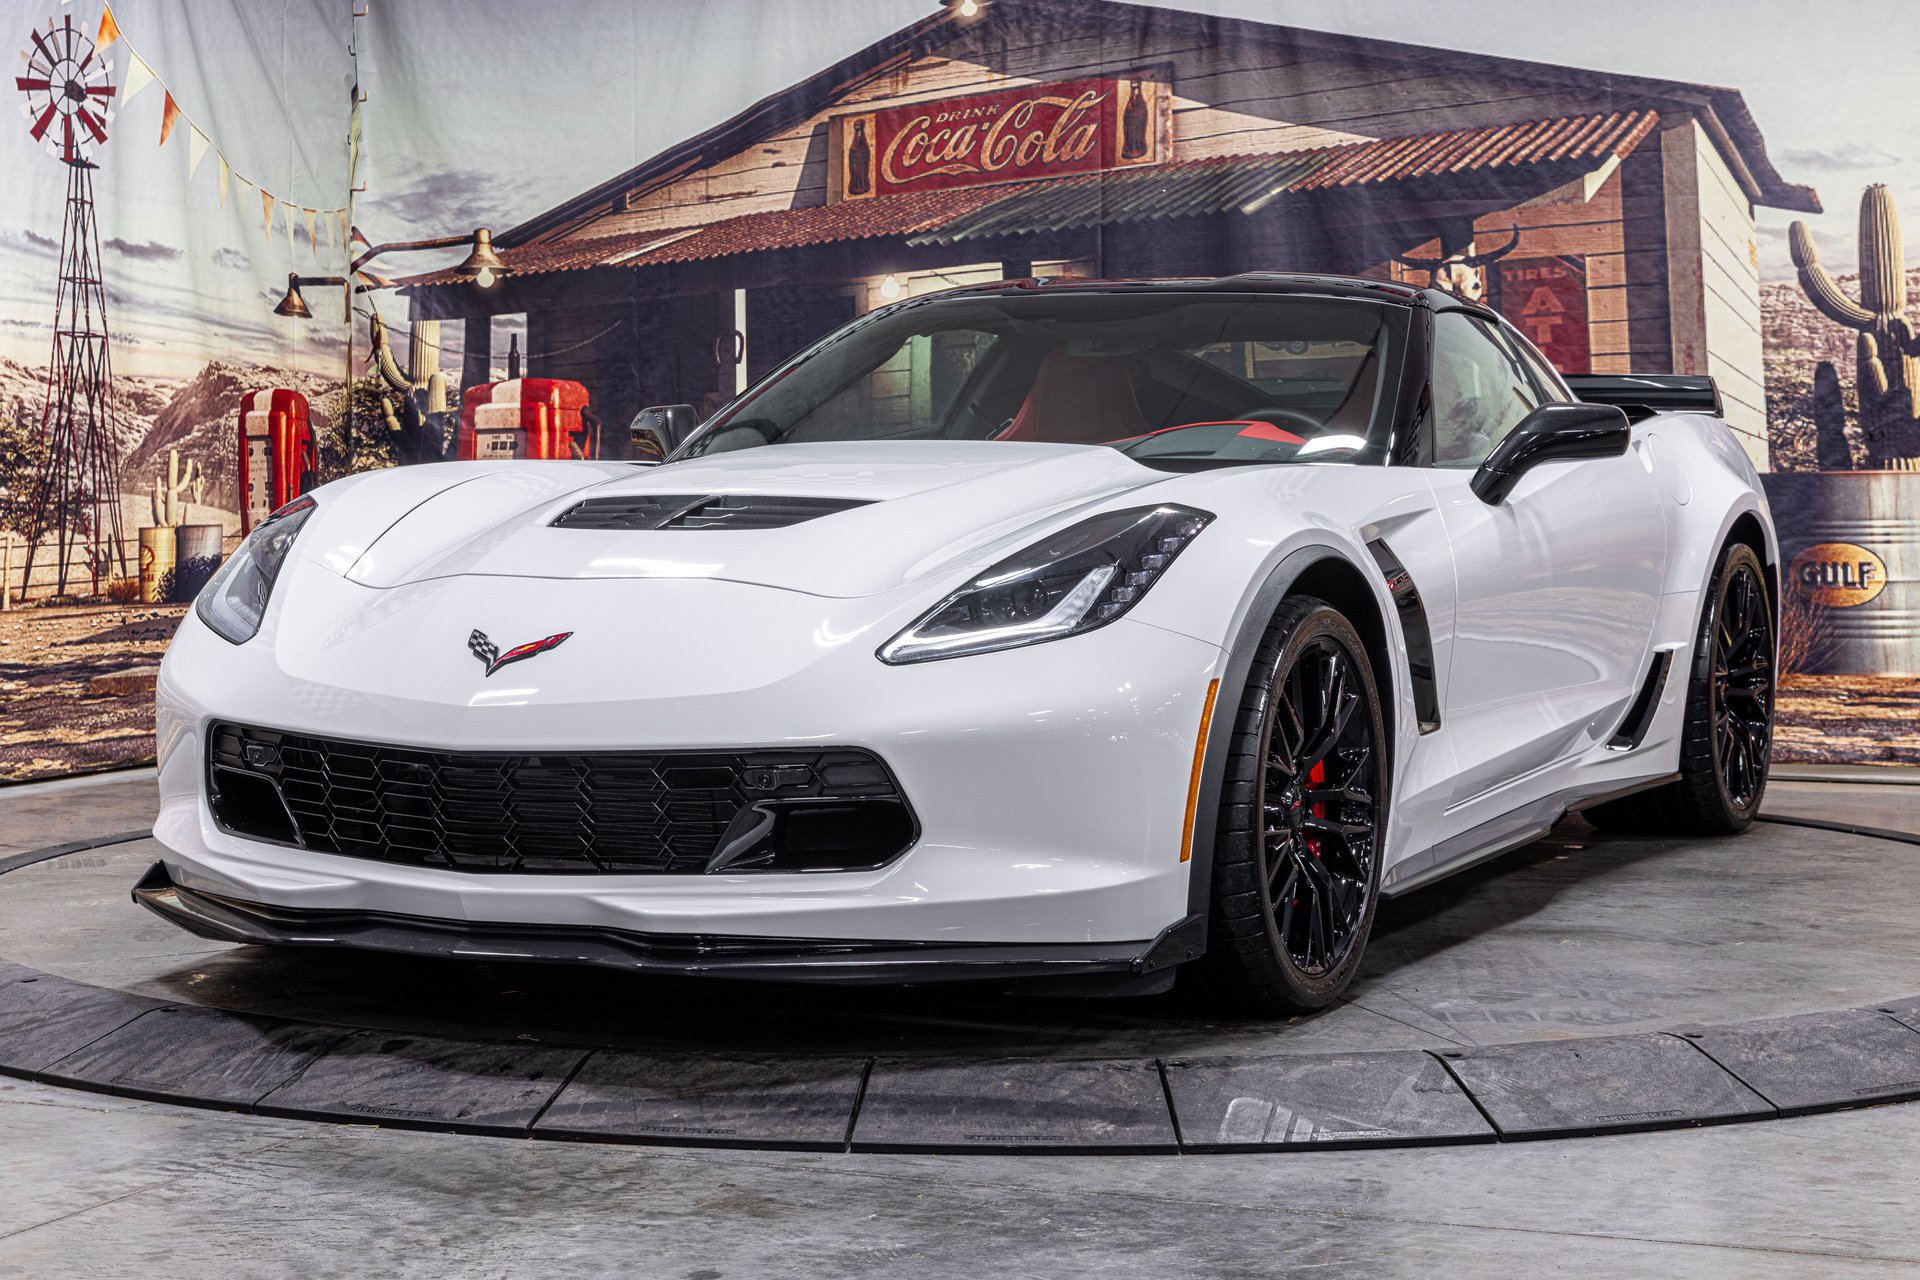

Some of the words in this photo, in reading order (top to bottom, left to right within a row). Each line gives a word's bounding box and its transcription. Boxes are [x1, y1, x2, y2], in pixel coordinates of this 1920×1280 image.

[936, 104, 1000, 123] DRINK
[881, 90, 1109, 183] Coca-Cola
[1503, 267, 1569, 282] TIRES
[1800, 561, 1874, 588] GULF
